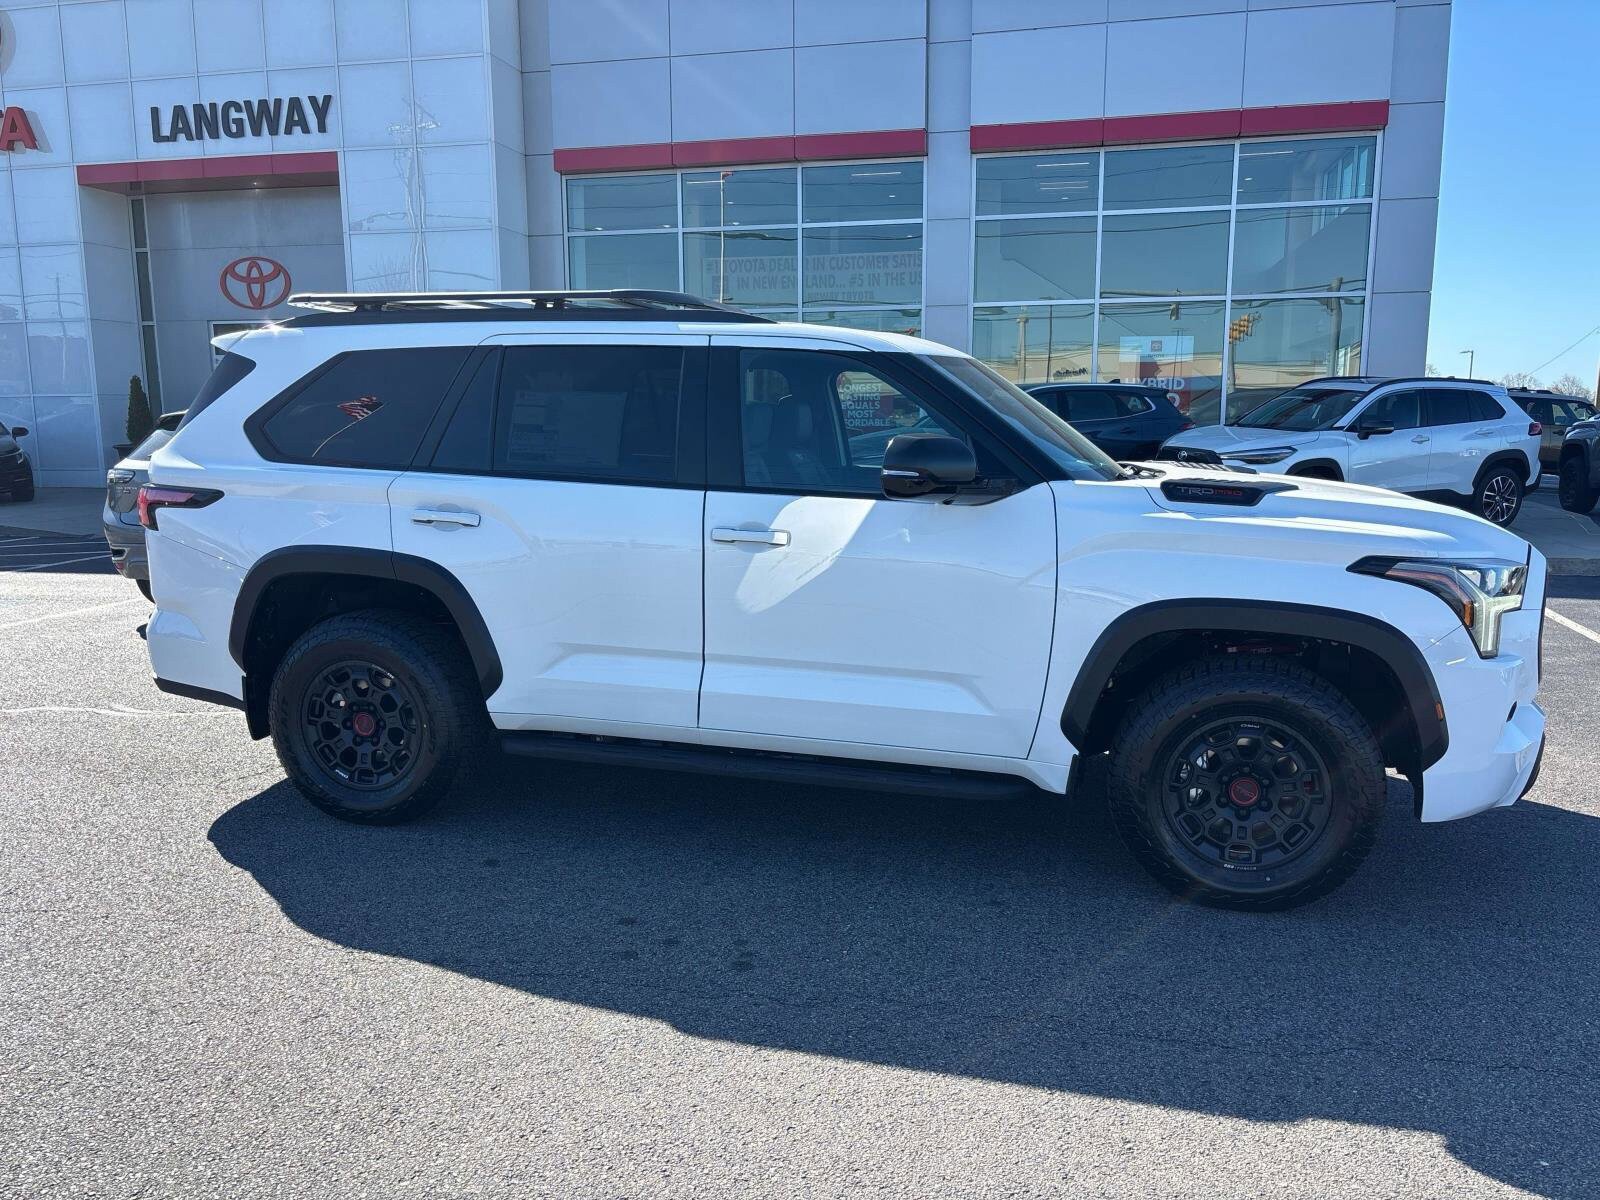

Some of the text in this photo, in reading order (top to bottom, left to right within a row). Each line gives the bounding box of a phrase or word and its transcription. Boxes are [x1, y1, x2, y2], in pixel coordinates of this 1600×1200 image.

[150, 95, 333, 143] LANGWAY
[0, 106, 40, 152] A
[769, 256, 810, 272] DEALR
[813, 256, 825, 271] IN
[829, 254, 889, 271] CUSTOMER
[737, 276, 749, 289] IN
[753, 275, 777, 289] NEW
[781, 272, 846, 289] ENLAND...
[868, 272, 880, 287] IN
[885, 271, 905, 287] THE
[1125, 377, 1185, 390] HYBRID
[842, 401, 881, 410] EQUALS
[848, 409, 874, 418] MOST
[1177, 486, 1214, 495] TRD
